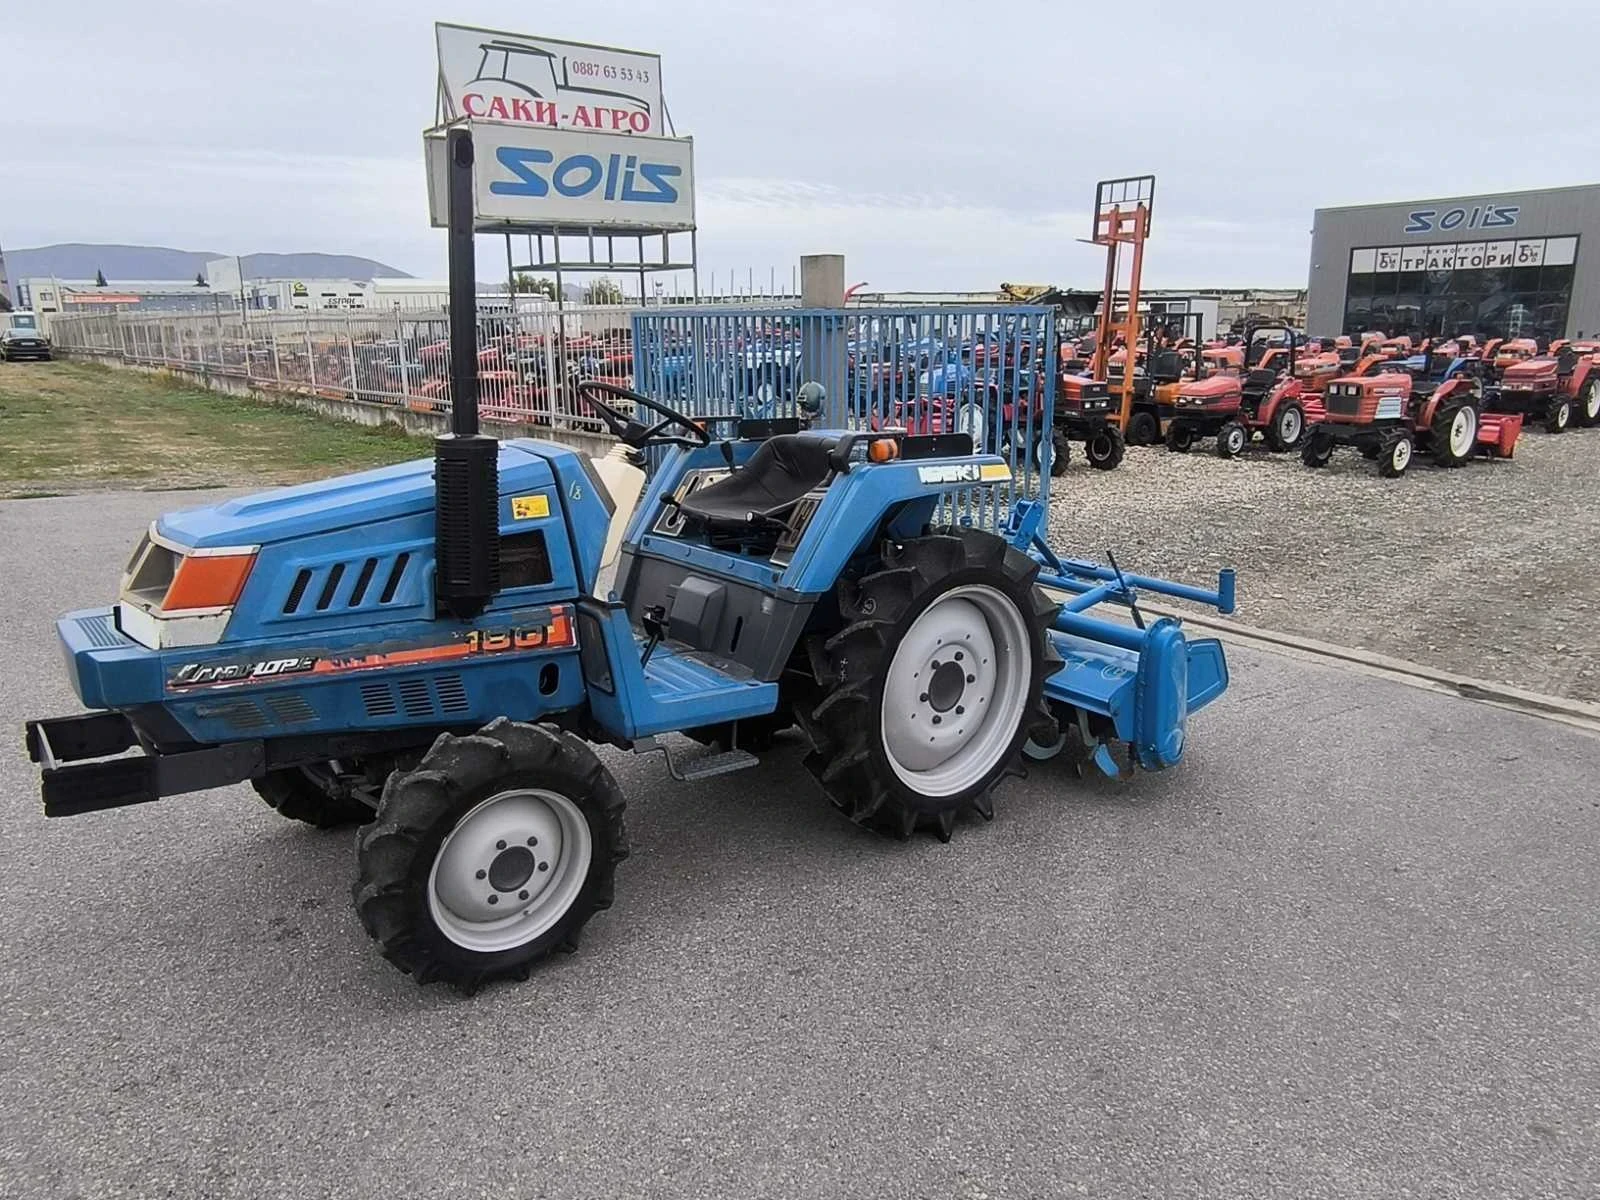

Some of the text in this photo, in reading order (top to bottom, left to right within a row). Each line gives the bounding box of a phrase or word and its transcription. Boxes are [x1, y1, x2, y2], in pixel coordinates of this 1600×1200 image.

[572, 60, 599, 76] 0887
[603, 65, 617, 79] 63
[620, 68, 633, 81] 53
[462, 93, 650, 132] САКИ-АГРО
[1403, 254, 1512, 269] ТРАКТОРИ
